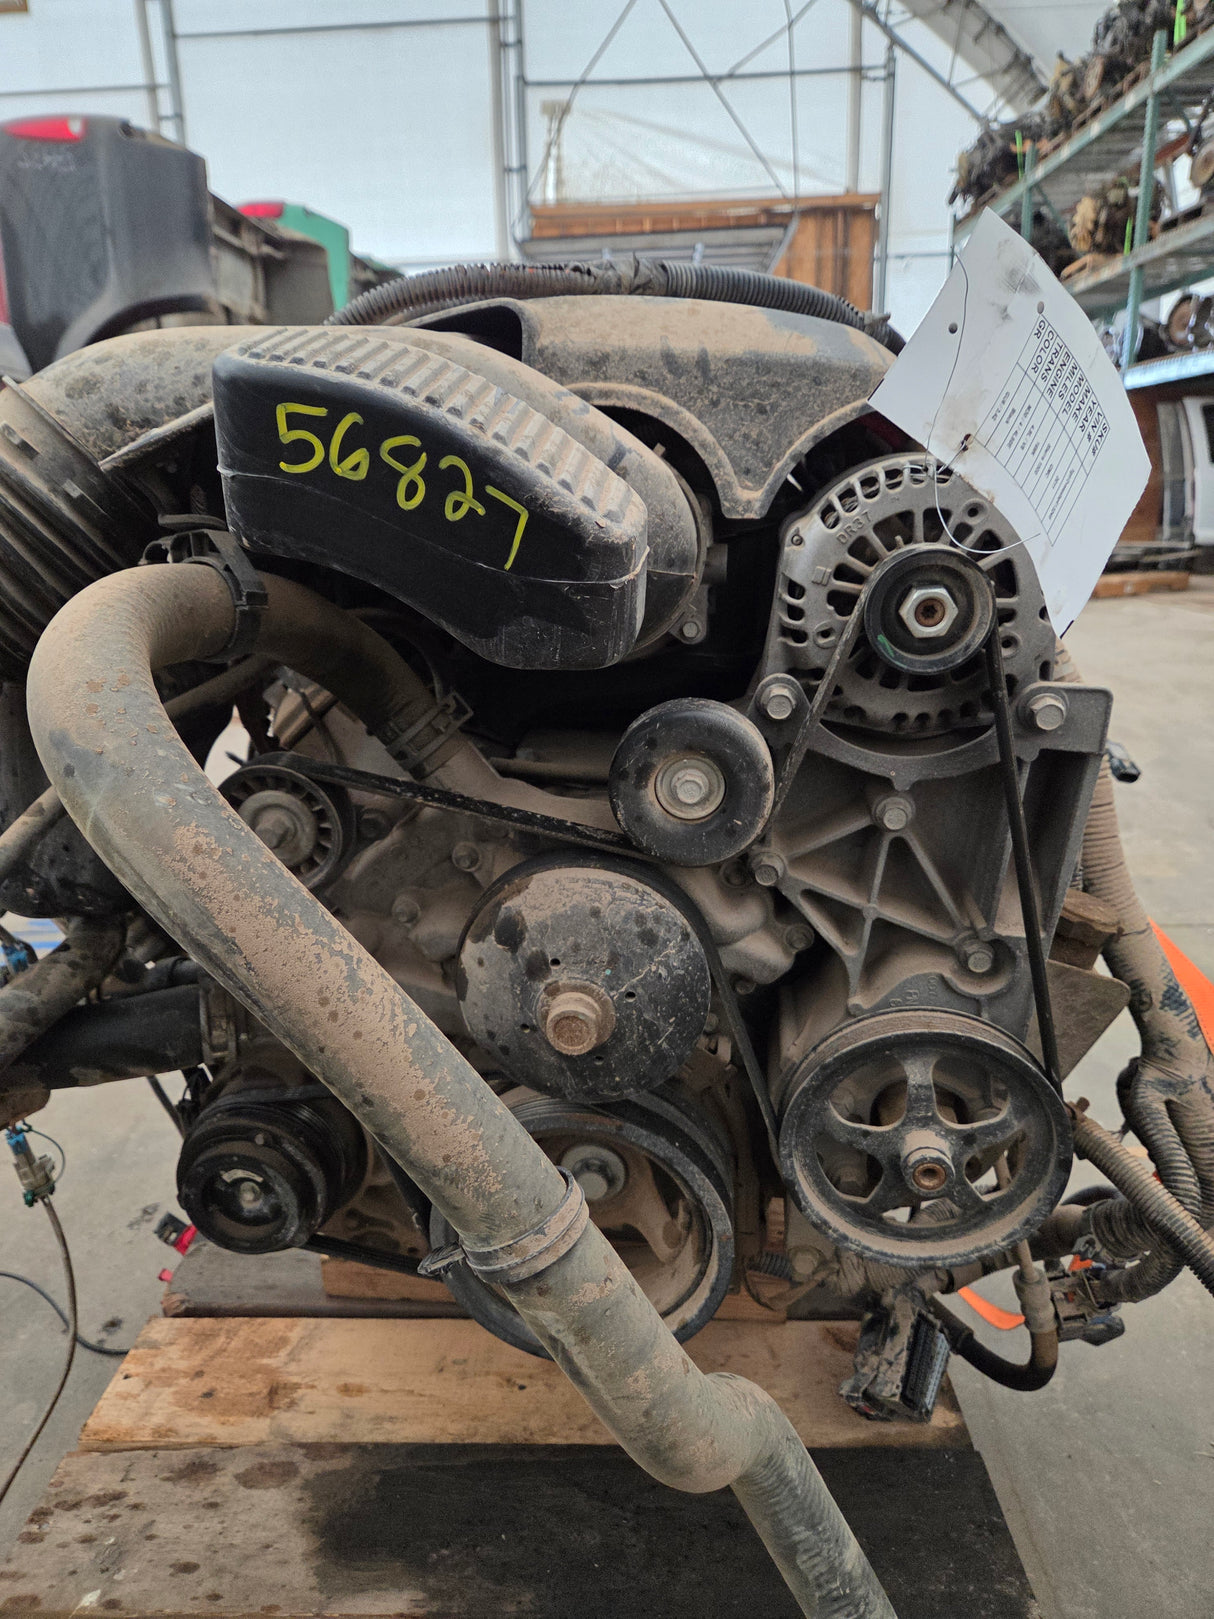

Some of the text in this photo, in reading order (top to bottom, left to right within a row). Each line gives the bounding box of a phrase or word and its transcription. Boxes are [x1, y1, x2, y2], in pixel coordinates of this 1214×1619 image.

[1034, 320, 1046, 339] GR
[1031, 330, 1055, 374] COLOR
[1041, 342, 1063, 382] TRANS
[1046, 351, 1071, 398] ENGINE
[1058, 362, 1078, 400] MILES
[1062, 373, 1084, 415] MODEL
[1072, 385, 1091, 423] MAKE
[1079, 400, 1097, 432] YEAR
[1091, 411, 1103, 433] VIN
[1091, 422, 1108, 456] SKU#
[276, 402, 529, 571] 56827
[836, 509, 871, 545] DR37
